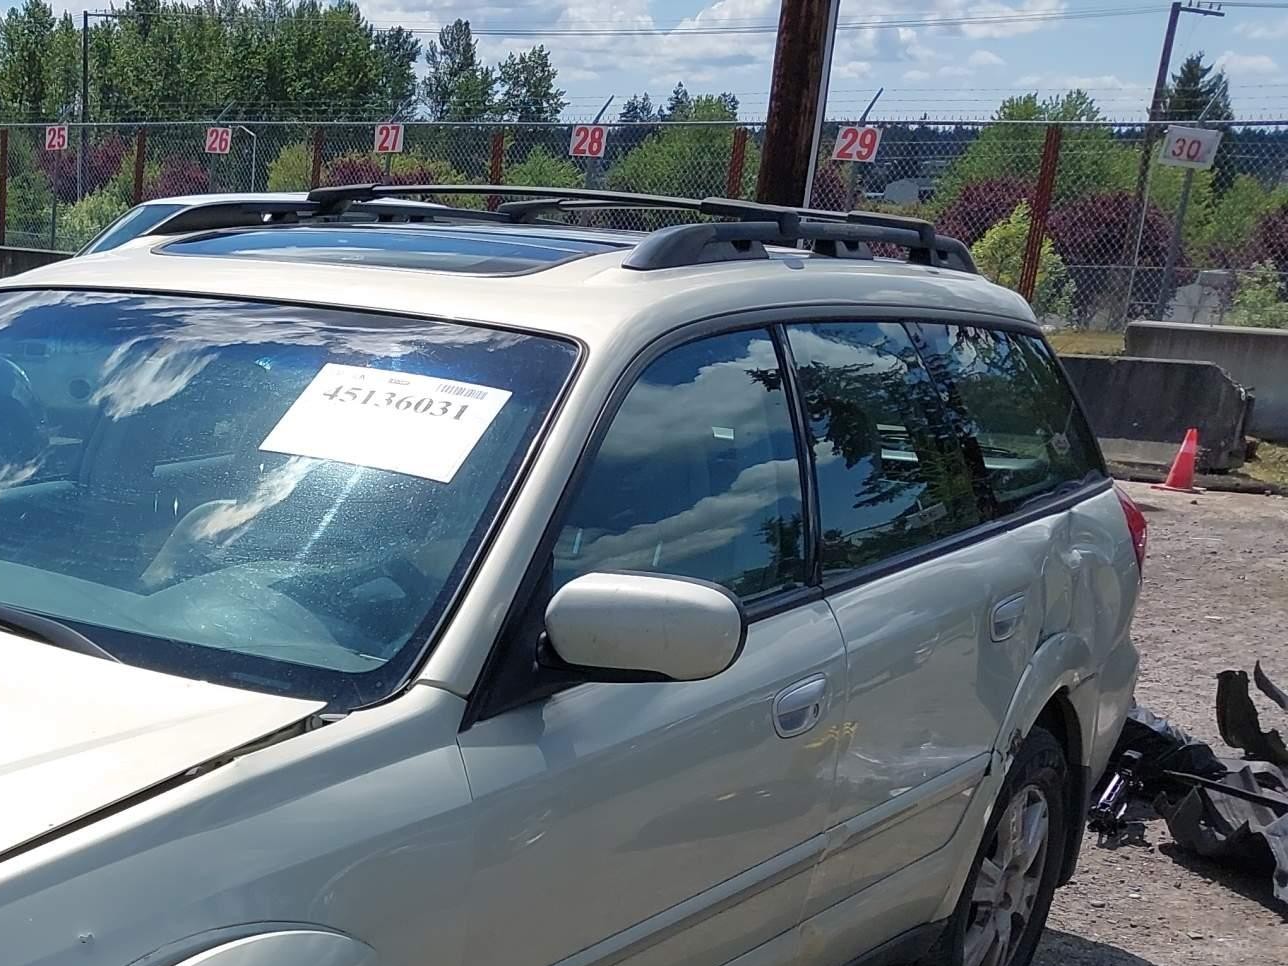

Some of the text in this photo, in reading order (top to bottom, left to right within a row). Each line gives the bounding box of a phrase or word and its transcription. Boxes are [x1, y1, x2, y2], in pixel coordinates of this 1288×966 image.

[48, 128, 66, 148] 25
[207, 129, 229, 151] 26
[378, 126, 400, 151] 27
[573, 127, 604, 156] 28
[836, 128, 878, 160] 29
[1172, 137, 1201, 160] 30
[323, 385, 469, 420] 45136031
